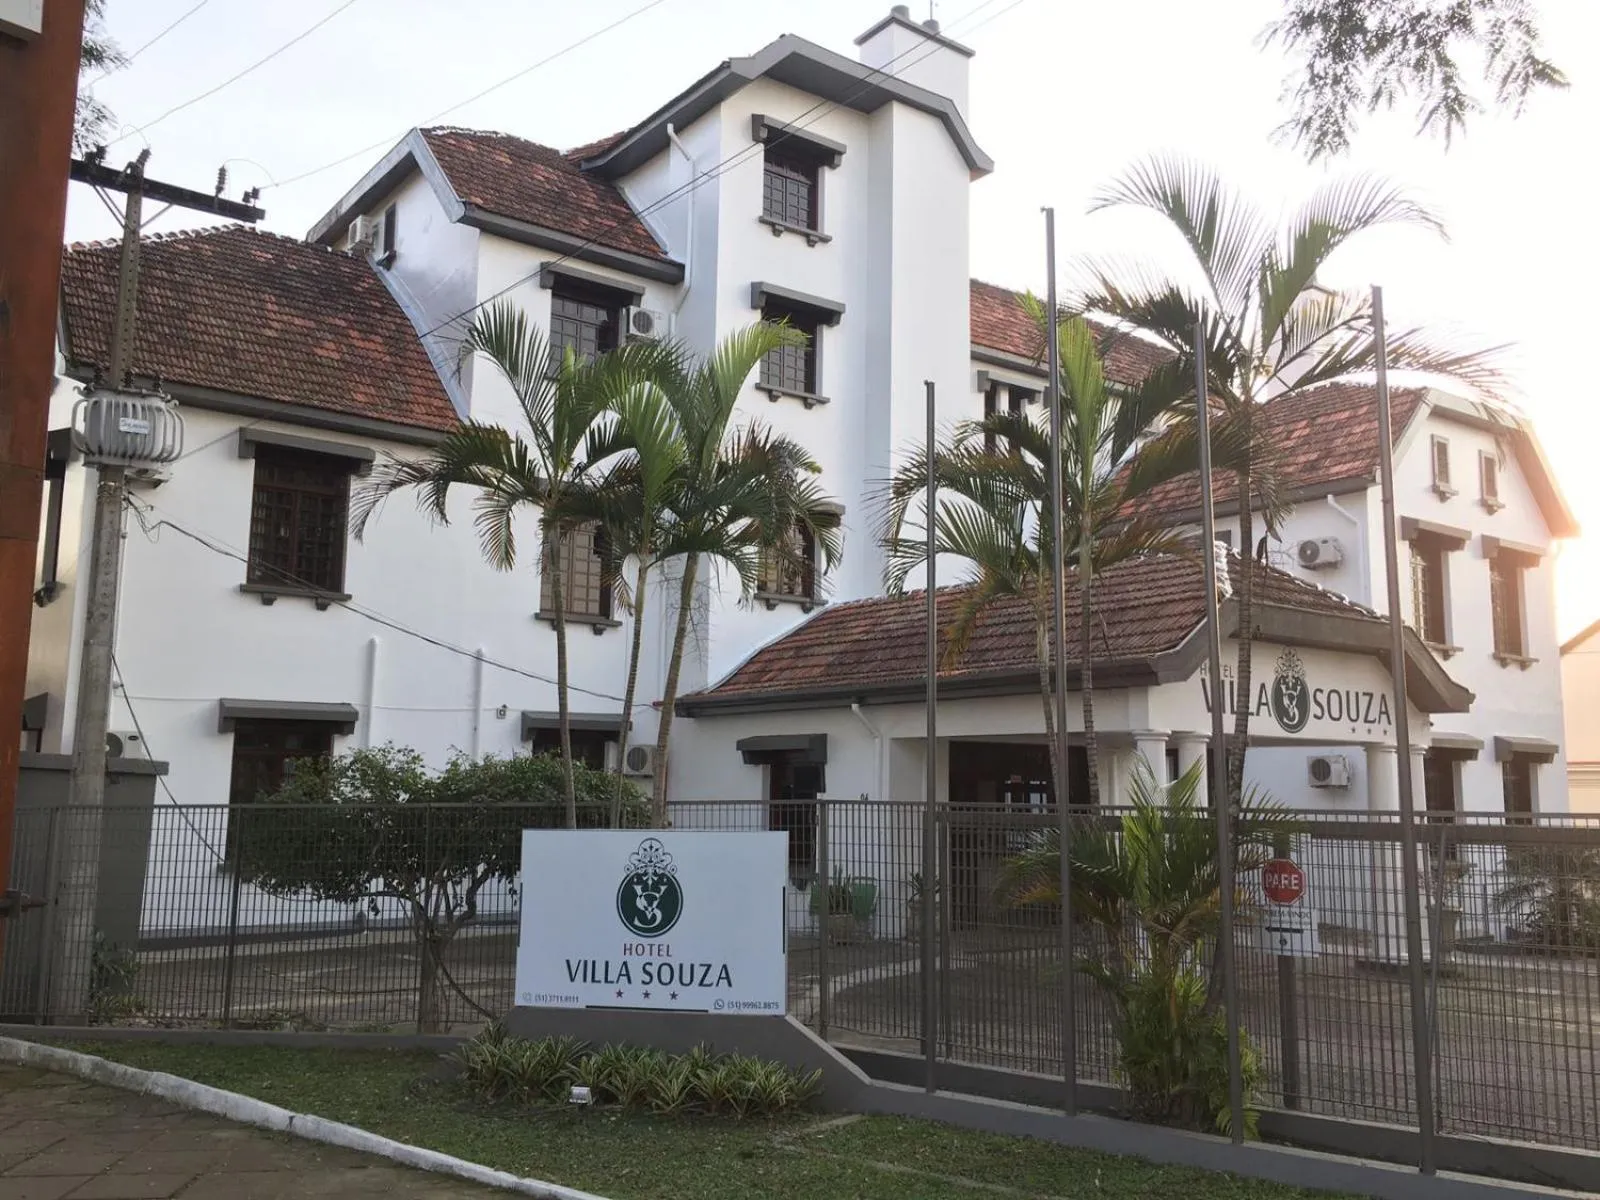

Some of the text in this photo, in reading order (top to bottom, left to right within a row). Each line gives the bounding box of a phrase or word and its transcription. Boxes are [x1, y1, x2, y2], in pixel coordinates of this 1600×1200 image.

[1312, 687, 1392, 726] SOUZA
[623, 943, 673, 957] HOTEL
[565, 959, 733, 988] VILLA SOUZA
